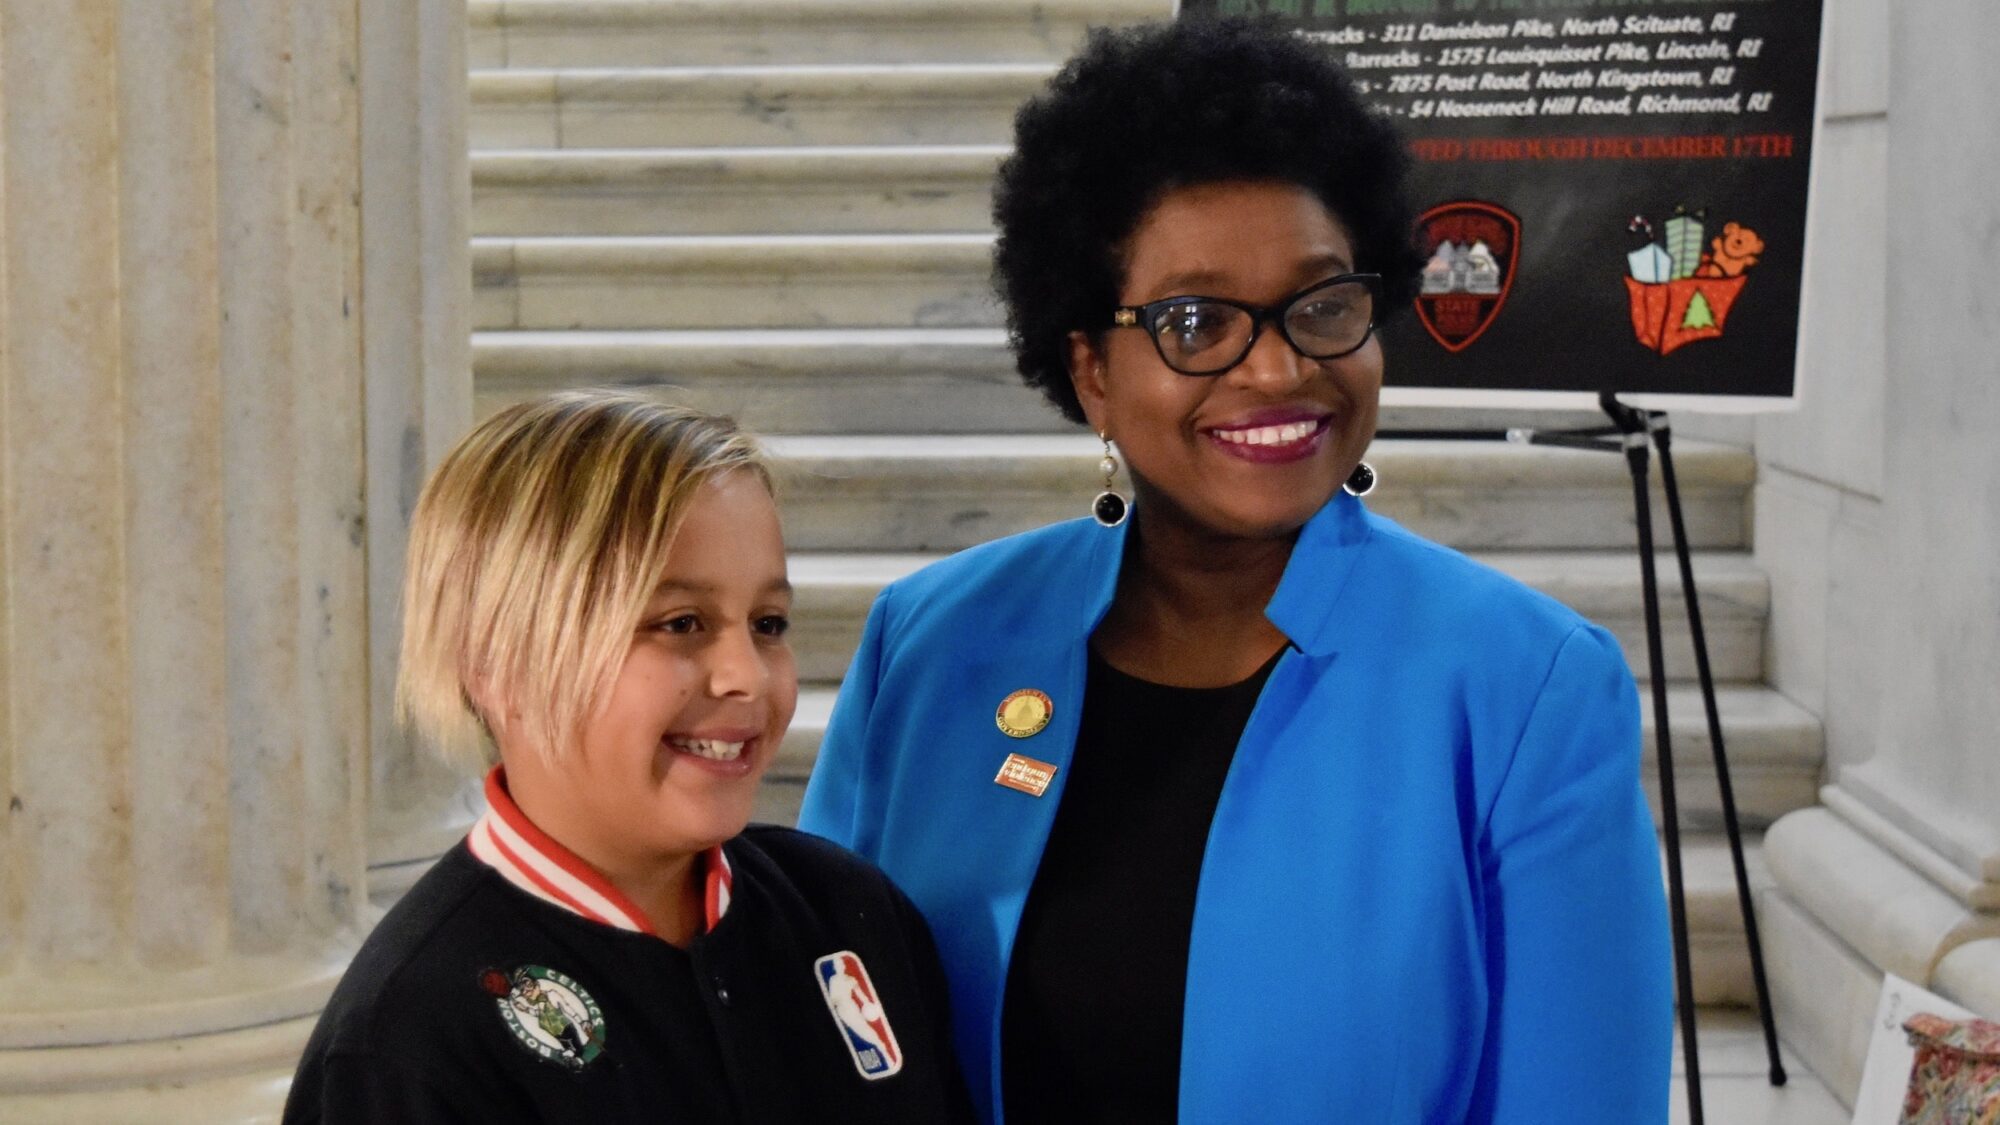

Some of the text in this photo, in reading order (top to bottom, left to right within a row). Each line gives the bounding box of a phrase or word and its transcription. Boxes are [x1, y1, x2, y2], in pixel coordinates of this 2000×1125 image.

[1381, 23, 1416, 42] 311
[1418, 20, 1508, 42] Danielson
[1512, 18, 1556, 39] Pike,
[1560, 16, 1619, 37] North
[1621, 13, 1704, 35] Scituate,
[1709, 12, 1737, 32] RI
[1346, 51, 1420, 69] Barracks
[1437, 48, 1484, 67] 1575
[1486, 44, 1602, 67] Louisquisset
[1604, 42, 1650, 62] Pike,
[1655, 39, 1731, 61] Lincoln,
[1736, 37, 1764, 59] RI
[1387, 74, 1434, 93] 7875
[1434, 73, 1477, 92] Post
[1479, 71, 1531, 92] Road,
[1535, 68, 1593, 89] North
[1596, 68, 1703, 92] Kingstown,
[1709, 66, 1736, 86] RI
[1408, 100, 1435, 118] 54
[1435, 98, 1537, 118] Nooseneck
[1540, 96, 1576, 115] Hill
[1577, 95, 1632, 116] Road,
[1636, 93, 1741, 115] Richmond,
[1746, 92, 1774, 112] RI
[1467, 136, 1588, 160] THROUGH
[1592, 134, 1726, 159] DECEMBER
[545, 968, 605, 1026] CELTICS
[497, 998, 552, 1058] BOSTON
